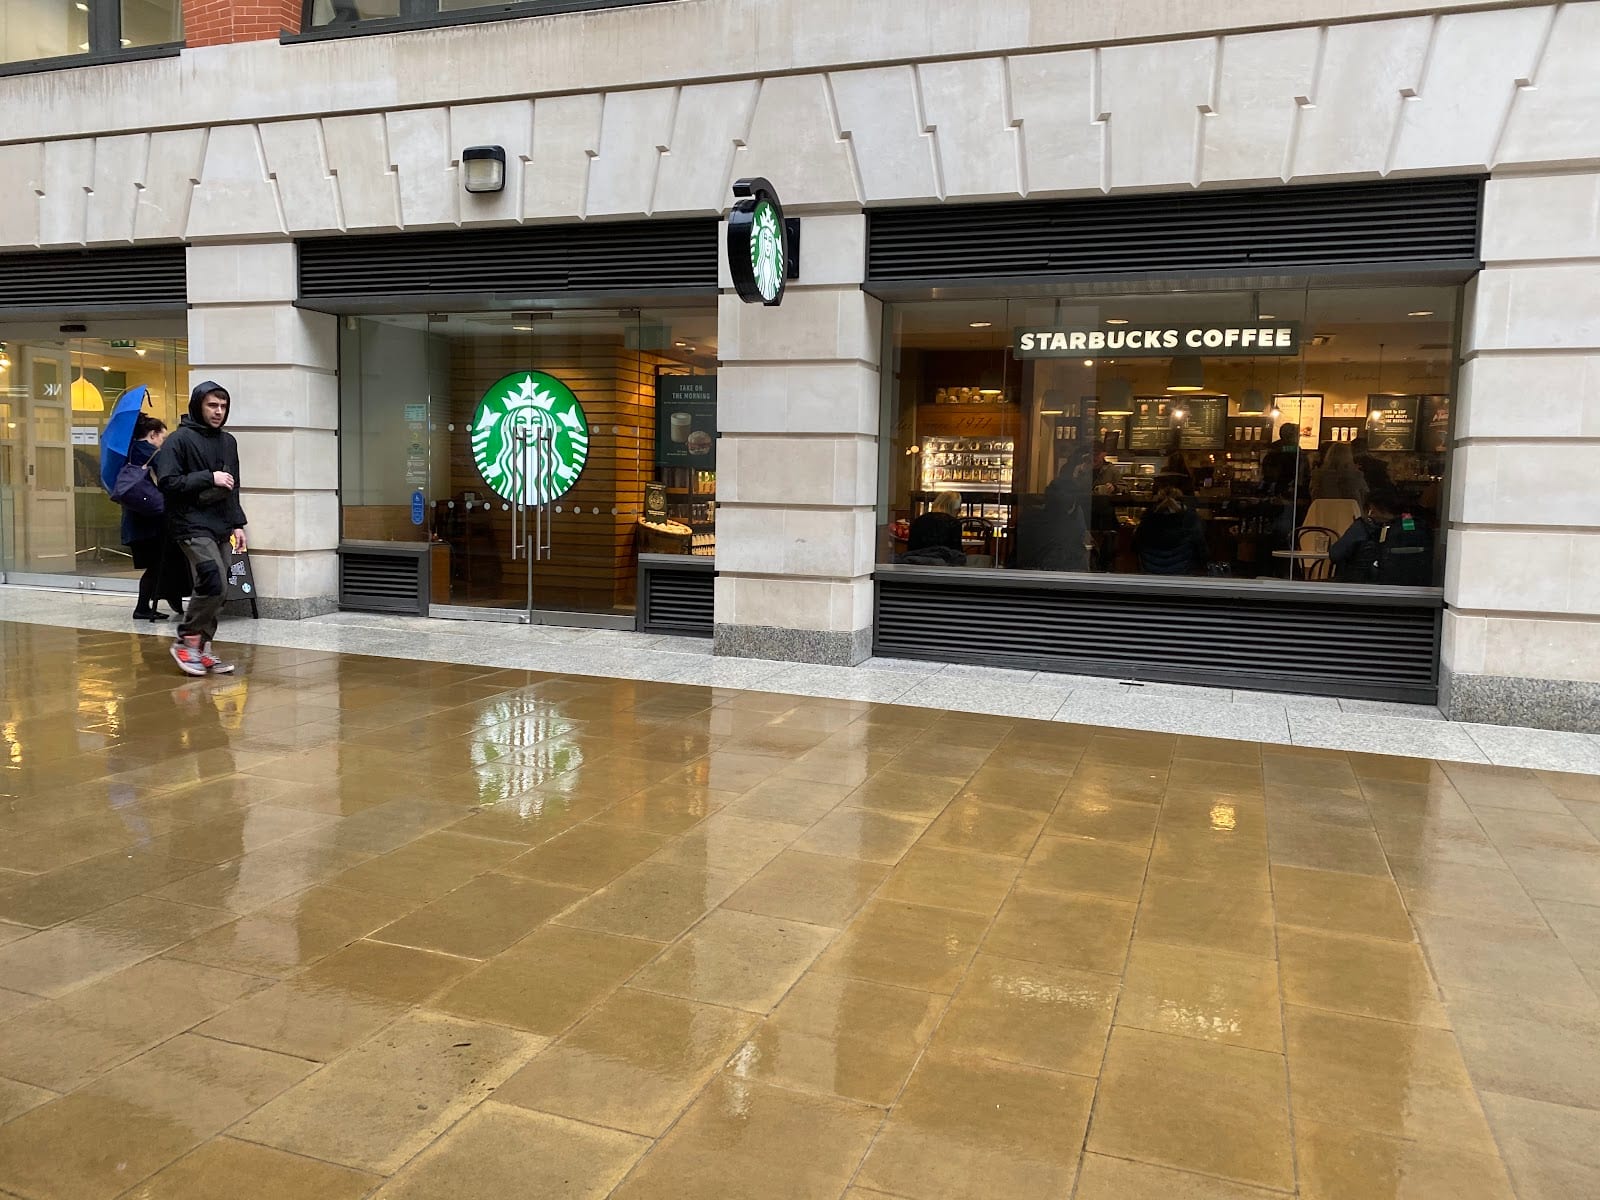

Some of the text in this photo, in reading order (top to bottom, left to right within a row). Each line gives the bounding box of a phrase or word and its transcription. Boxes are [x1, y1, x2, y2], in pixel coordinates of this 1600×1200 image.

[1020, 328, 1292, 350] STARBUCKS COFFEE
[680, 384, 703, 392] TAKE ON
[684, 392, 711, 400] MORNING
[957, 417, 992, 429] 1971
